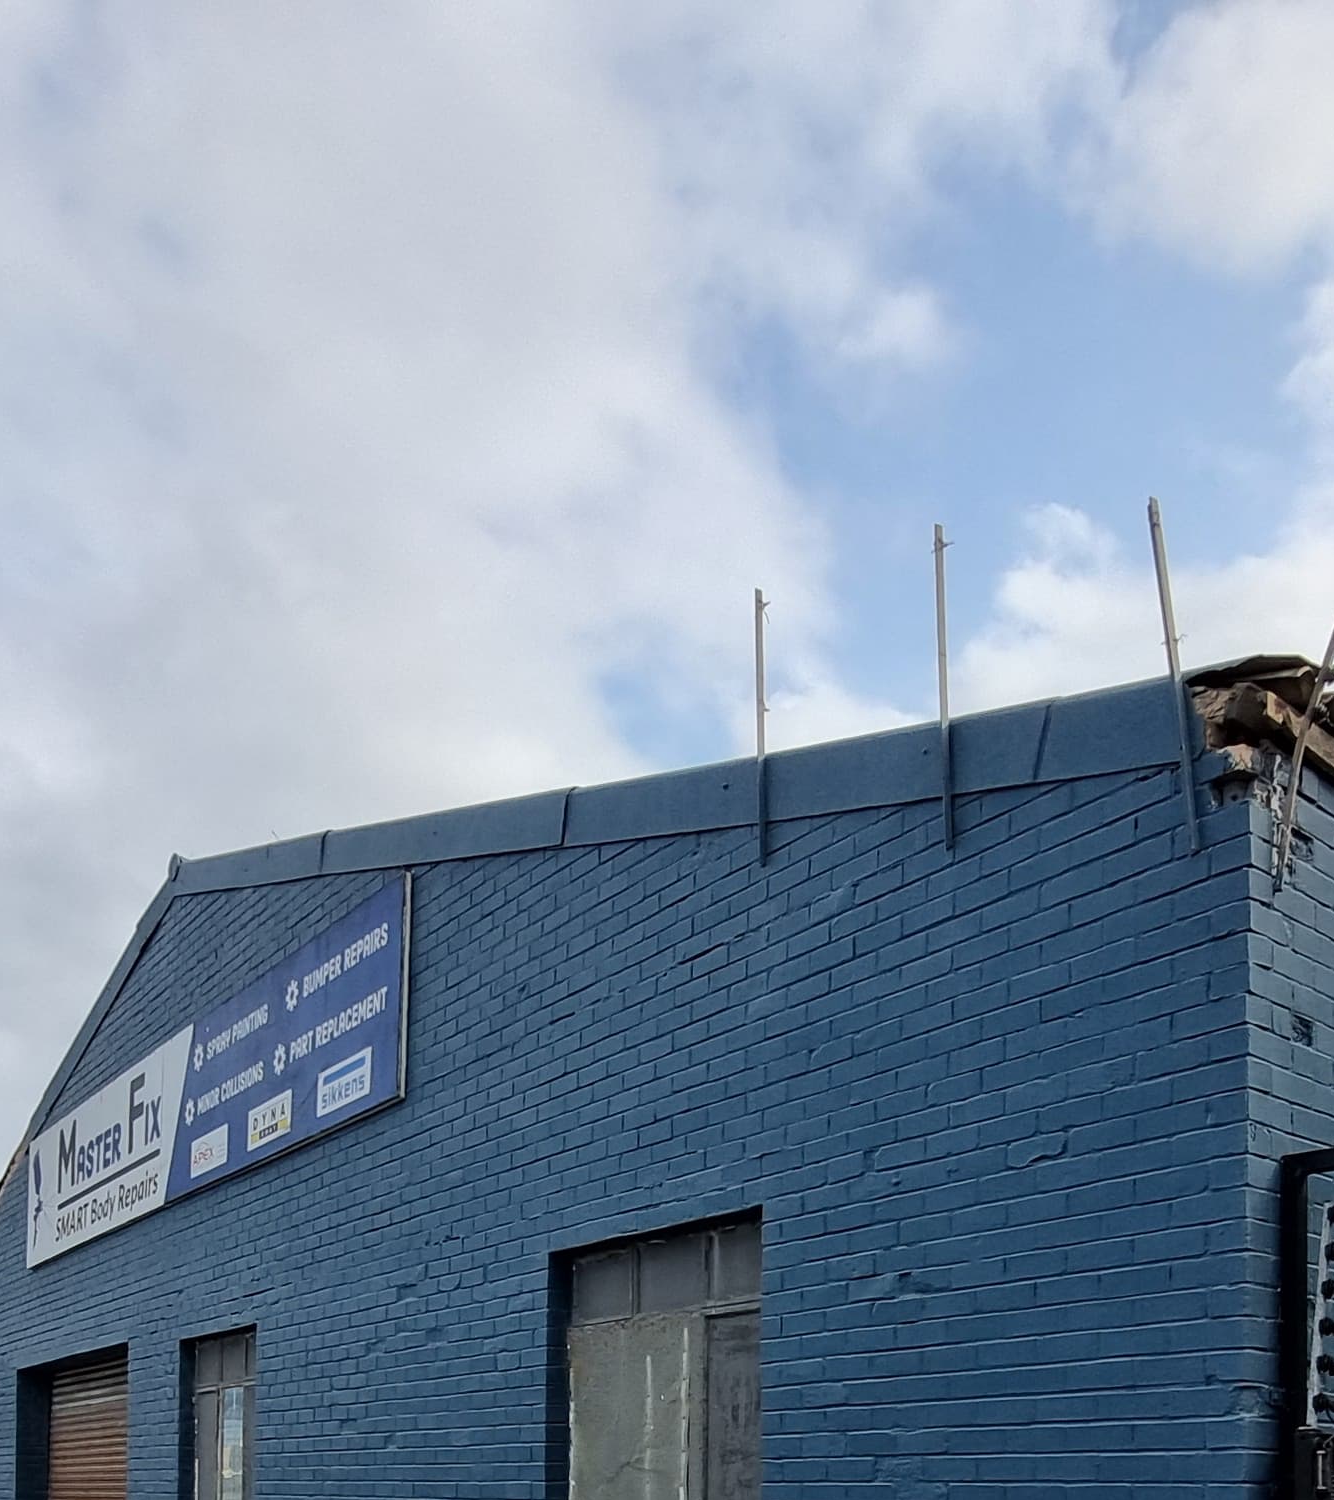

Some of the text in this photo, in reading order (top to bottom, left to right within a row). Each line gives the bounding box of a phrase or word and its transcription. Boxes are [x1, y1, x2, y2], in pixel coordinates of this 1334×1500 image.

[302, 922, 389, 998] BUMPER REPAIRS
[206, 1003, 269, 1060] SPRAY PAINTING
[289, 985, 388, 1063] PART REPLACEMENT
[196, 1060, 264, 1117] MINOR COLLISIONS
[252, 1103, 286, 1131] DYNA
[55, 1170, 159, 1242] SMART Body Repairs
